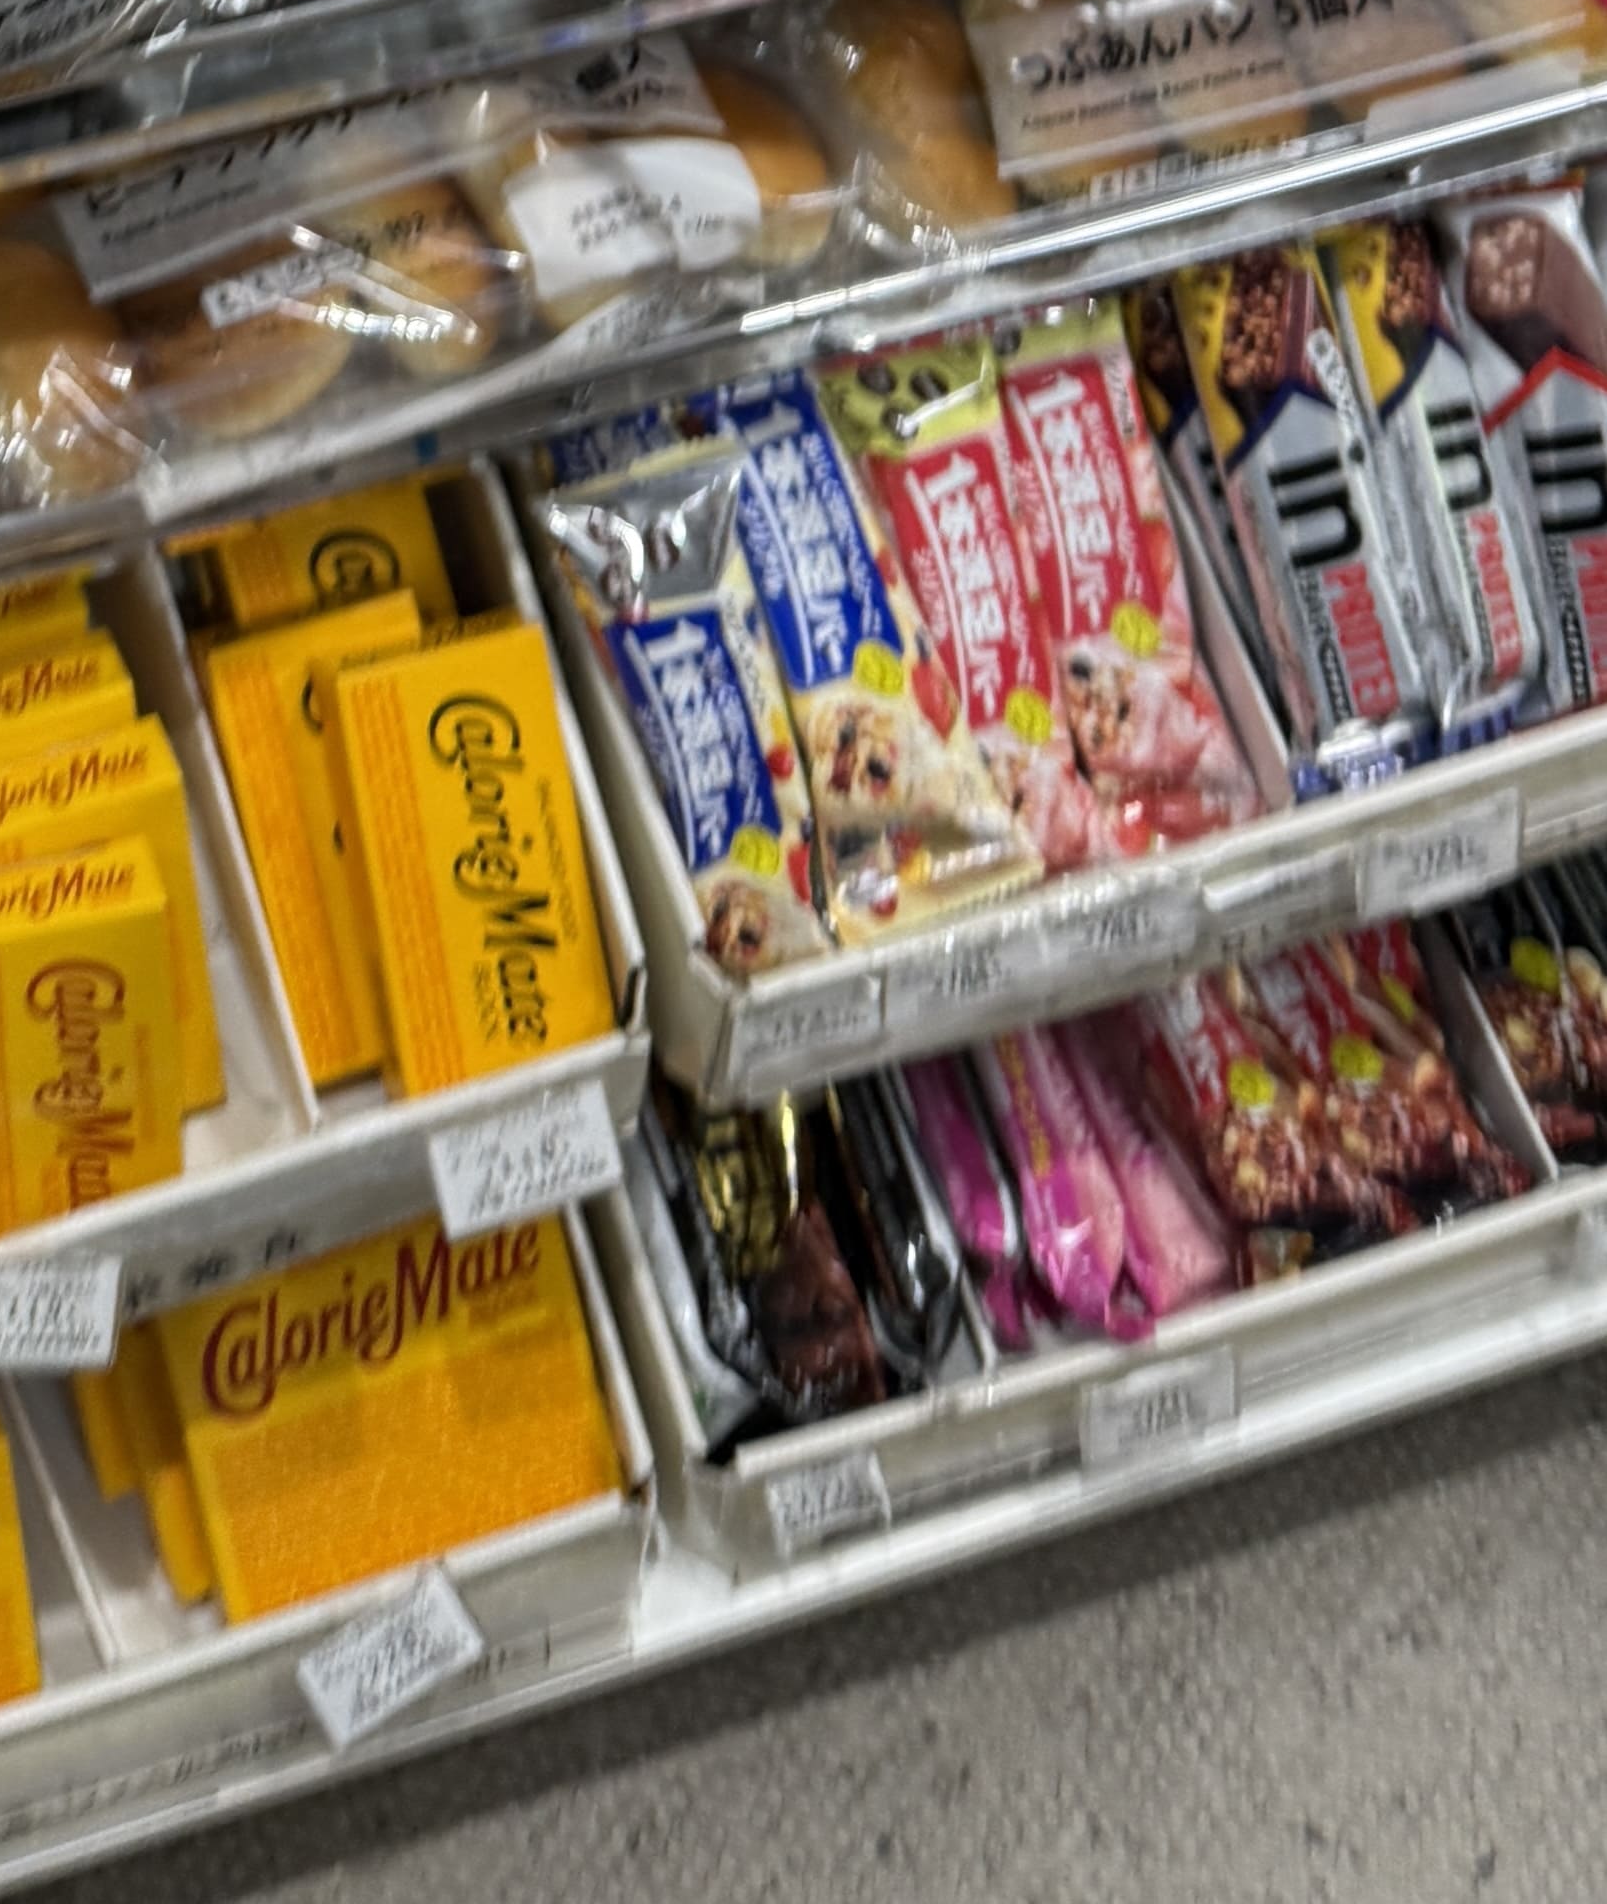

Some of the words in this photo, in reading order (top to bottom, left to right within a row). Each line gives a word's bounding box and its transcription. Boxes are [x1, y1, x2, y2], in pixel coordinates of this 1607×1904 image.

[1013, 7, 1254, 91] つぶあんパン
[427, 692, 560, 1046] CalorieMate
[201, 1218, 541, 1421] CalorieMate
